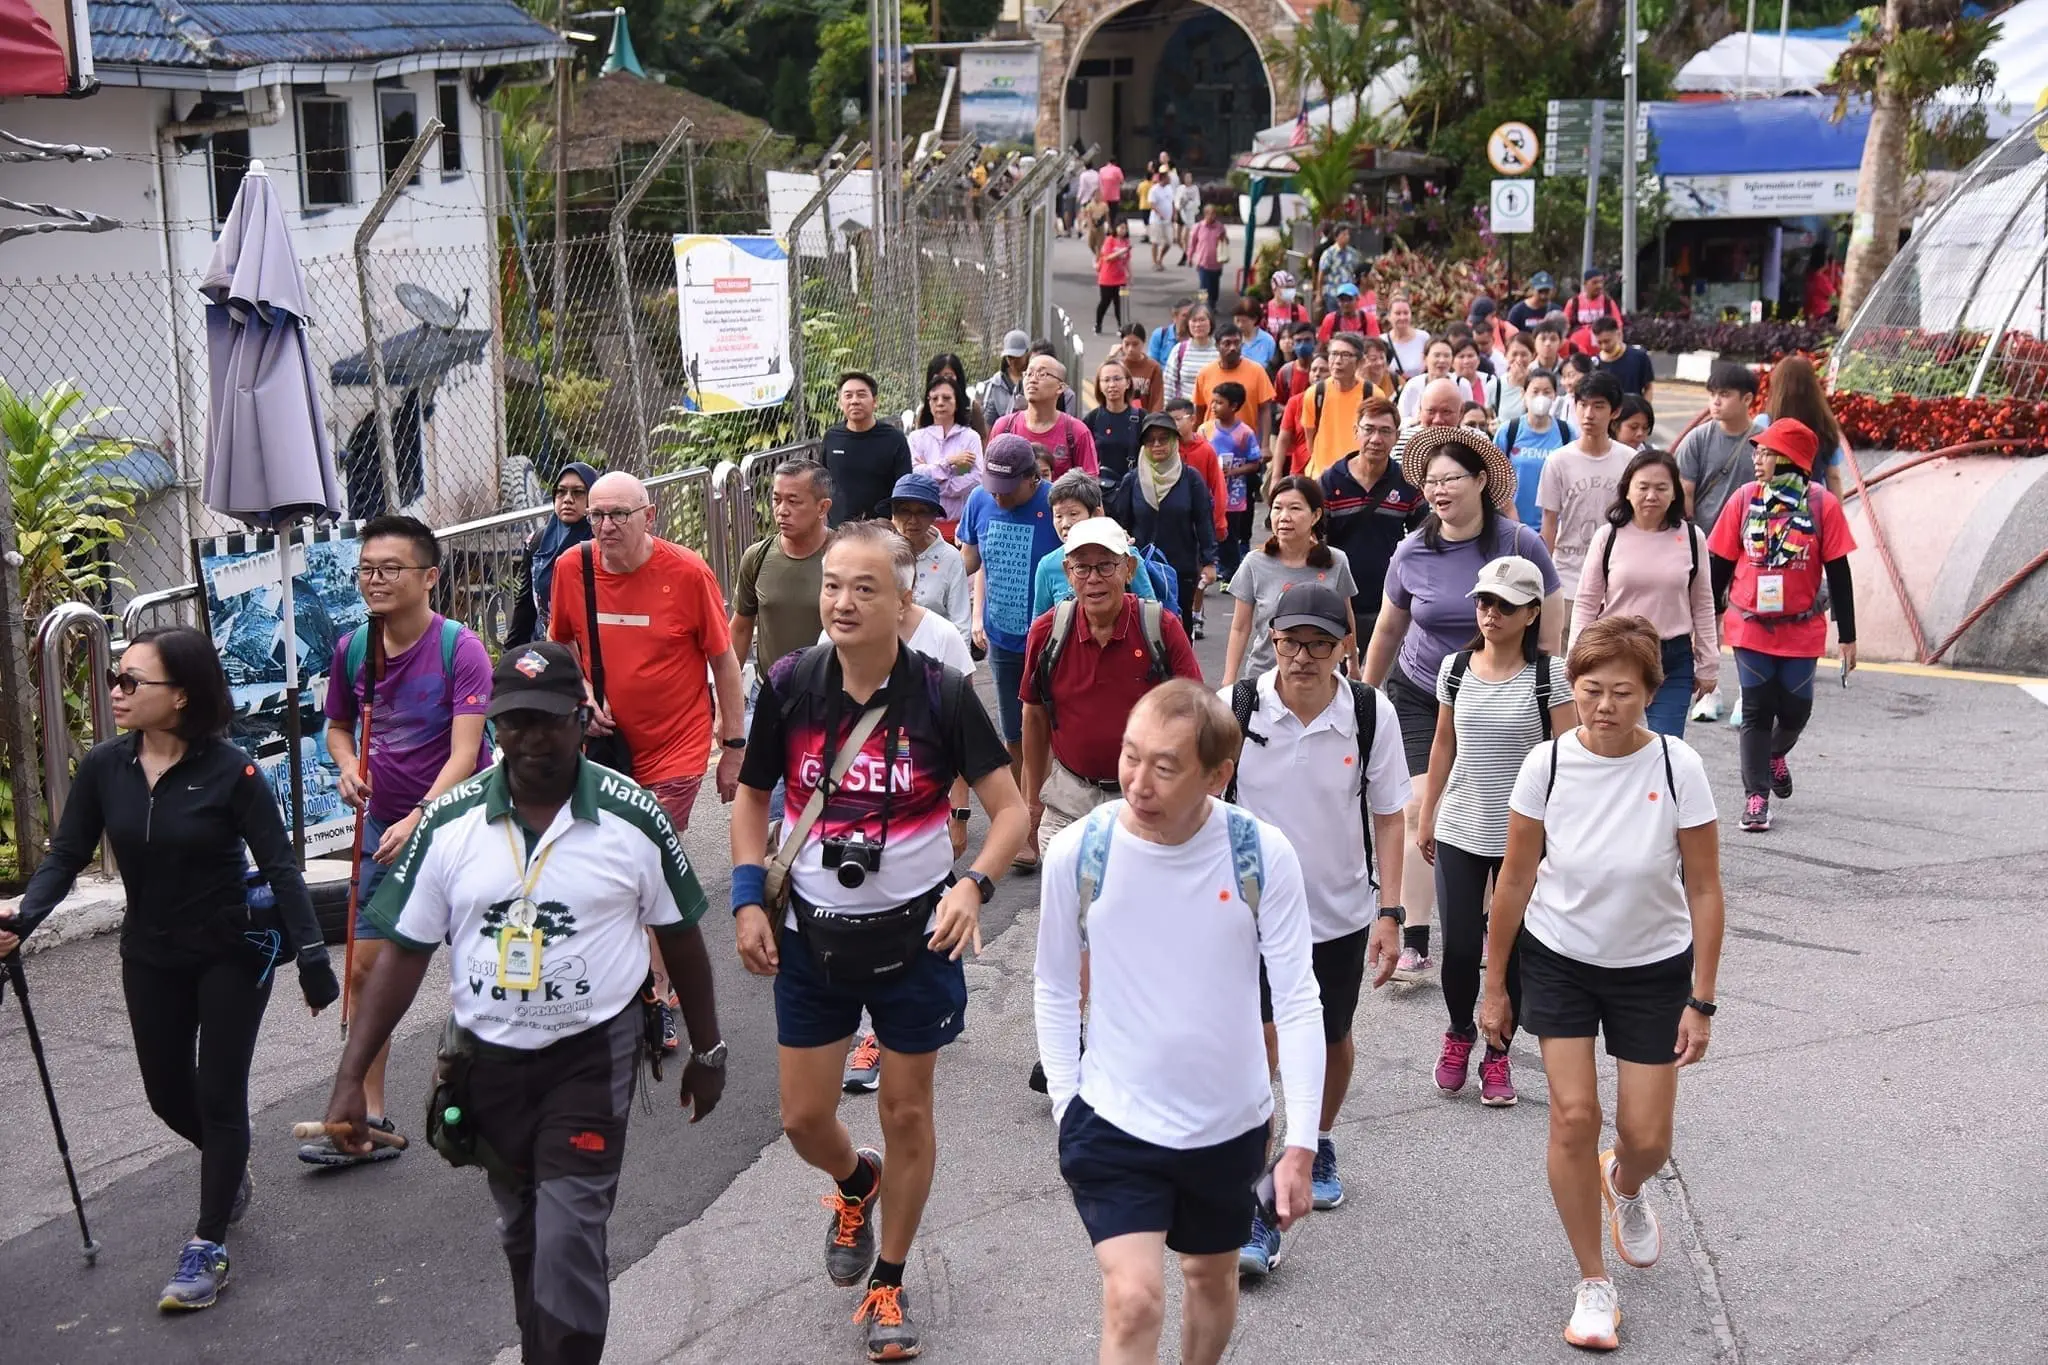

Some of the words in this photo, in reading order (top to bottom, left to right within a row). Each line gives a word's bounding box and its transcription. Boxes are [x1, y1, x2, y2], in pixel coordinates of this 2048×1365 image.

[1521, 447, 1550, 459] PENA
[802, 759, 911, 794] GSEN
[313, 826, 345, 842] TYPHOON
[529, 1003, 573, 1017] PENANG
[573, 998, 593, 1012] HILL
